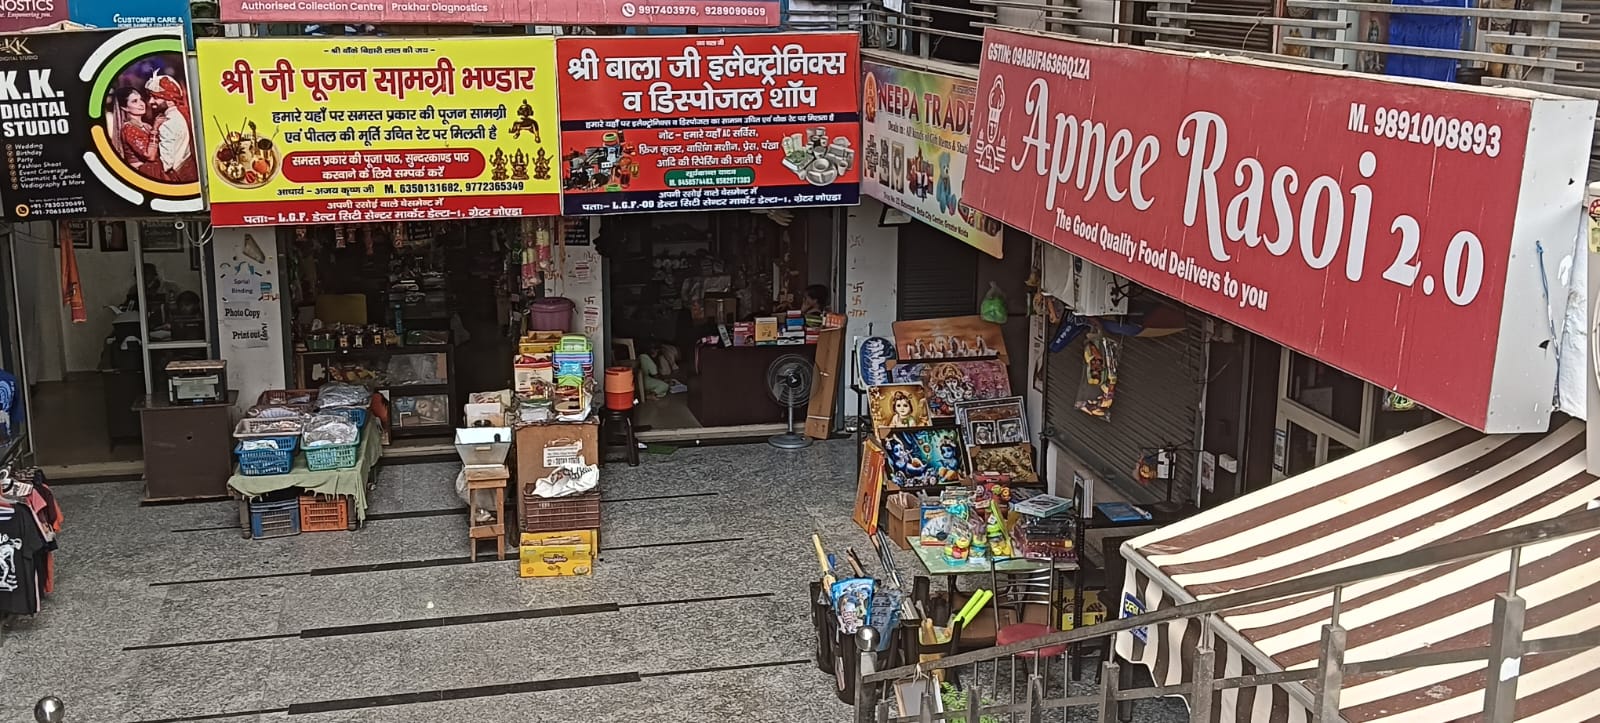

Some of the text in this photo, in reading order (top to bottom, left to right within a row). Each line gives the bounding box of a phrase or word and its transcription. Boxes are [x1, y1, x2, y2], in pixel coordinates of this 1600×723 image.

[242, 1, 488, 14] Authorised Collection Centre Prakhar Diagnostics
[638, 5, 766, 16] 9917403976, 9289090609
[987, 43, 1010, 64] GSTIN:
[567, 48, 600, 80] श्री
[605, 56, 662, 80] बाला
[666, 46, 701, 79] जी
[0, 69, 65, 100] K.K.
[221, 57, 536, 104] श्री जी पूजन सामग्री भण्डार
[622, 79, 818, 114] व डिस्पोजल शॉप
[0, 101, 70, 120] DIGITAL
[272, 103, 507, 125] हमारे यहाँ पर समस्त प्रकार की पूजन सामग्री
[2, 120, 70, 138] STUDIO
[285, 123, 498, 146] एवं पीतल की मूर्ति उचित रेट पर मिलती है
[658, 129, 675, 140] नोट
[1348, 102, 1501, 158] M. 9891008893
[15, 150, 43, 158] Birthday
[292, 155, 321, 166] समस्त
[322, 154, 347, 167] प्रकार
[349, 151, 361, 165] की
[363, 154, 383, 169] पूजा
[454, 152, 470, 163] पाठ
[677, 156, 690, 167] की
[19, 168, 69, 177] Event Coverage
[43, 161, 63, 169] Shoot
[358, 167, 372, 179] के
[20, 175, 51, 183] Cinematic
[59, 172, 82, 181] Candid
[69, 179, 86, 187] More
[1011, 77, 1485, 307] Apnee Rasoi 2.0
[1055, 206, 1269, 311] The Good Quality Food Delivers to you
[225, 307, 261, 320] Photo Copy
[232, 330, 249, 340] Print
[250, 331, 260, 339] out
